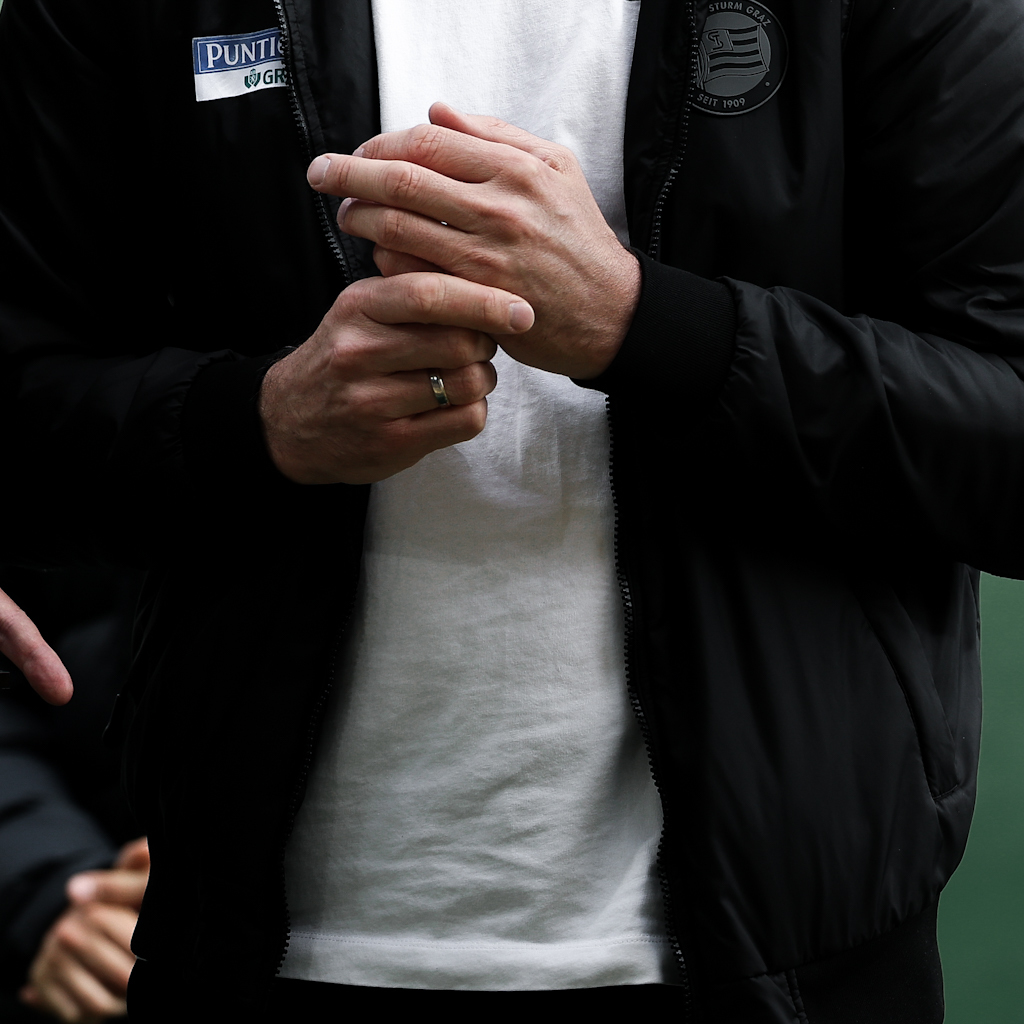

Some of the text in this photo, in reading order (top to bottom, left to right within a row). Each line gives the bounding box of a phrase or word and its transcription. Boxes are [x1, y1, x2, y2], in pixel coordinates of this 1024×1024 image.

[709, 1, 771, 27] STURM GRAZ
[696, 93, 746, 109] SEIT 1909
